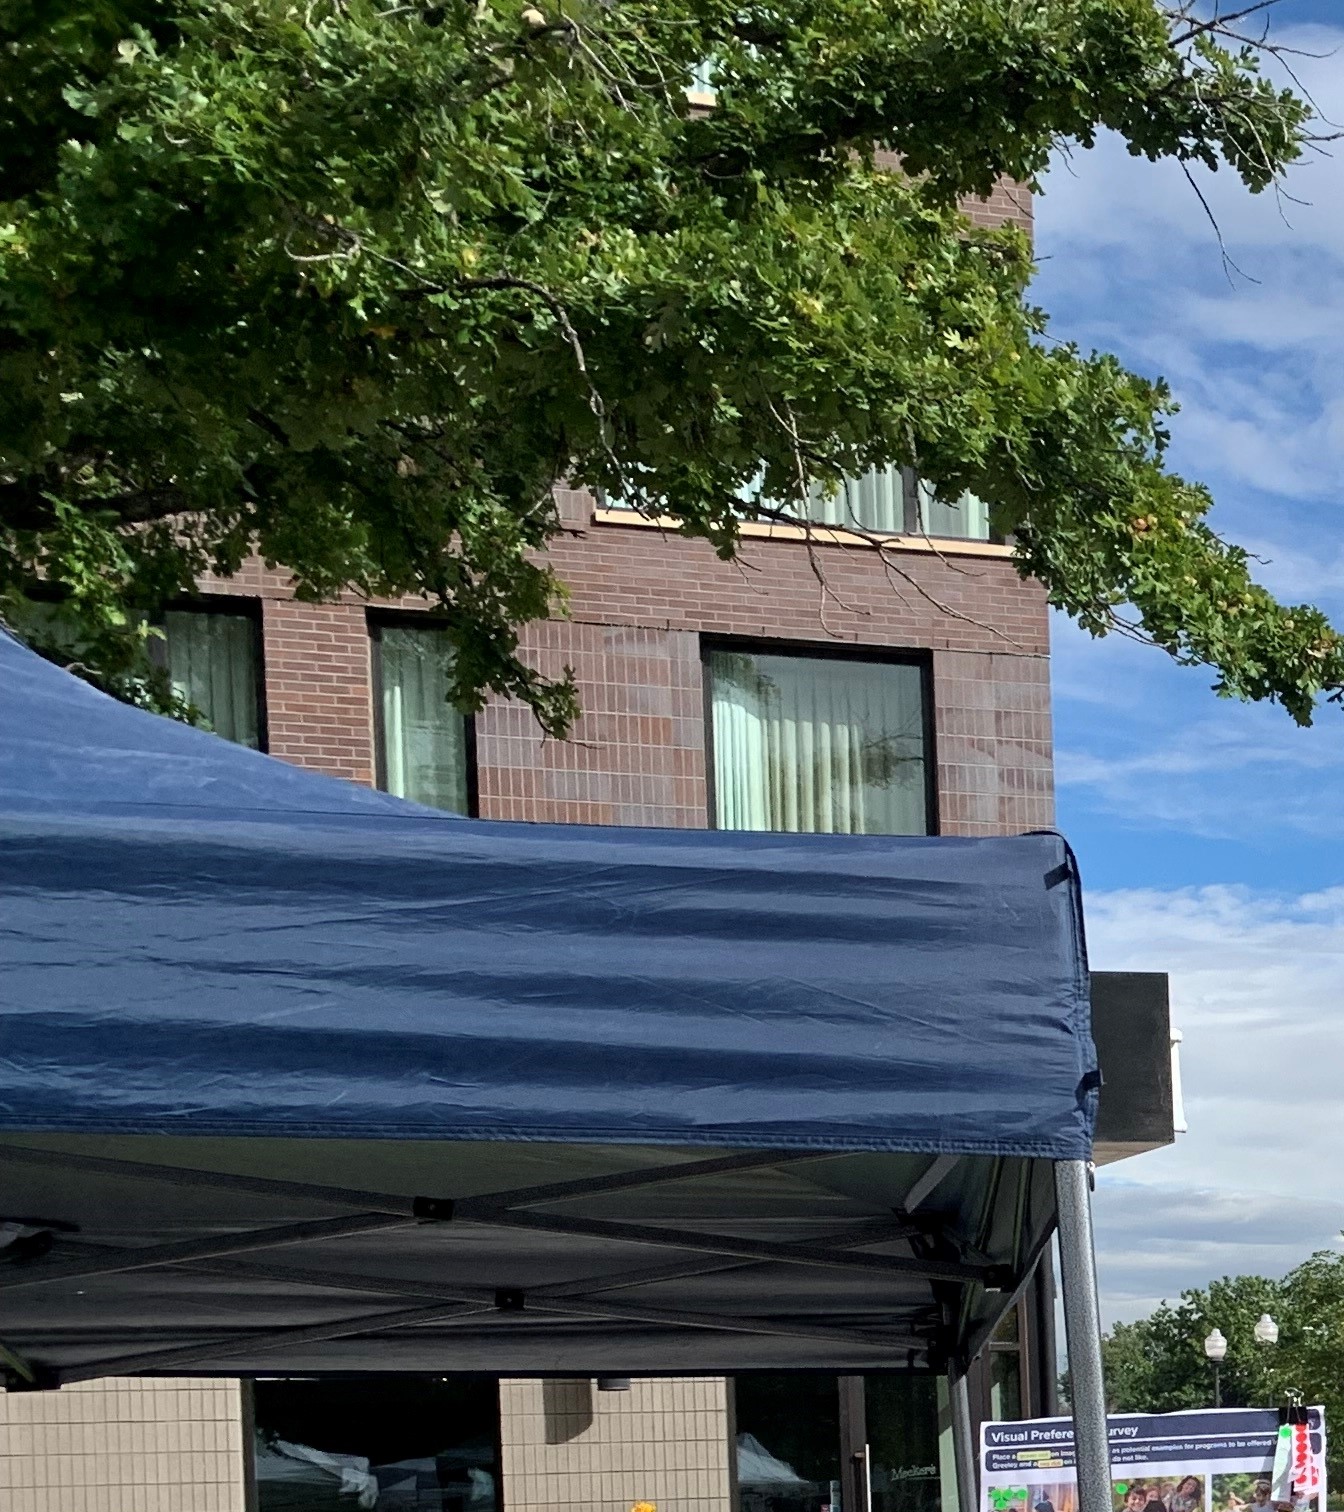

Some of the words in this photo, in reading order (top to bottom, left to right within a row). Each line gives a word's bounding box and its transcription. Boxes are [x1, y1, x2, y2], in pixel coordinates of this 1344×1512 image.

[992, 1431, 1027, 1442] Visual
[1031, 1430, 1074, 1441] Prefere
[1109, 1426, 1138, 1437] urvey
